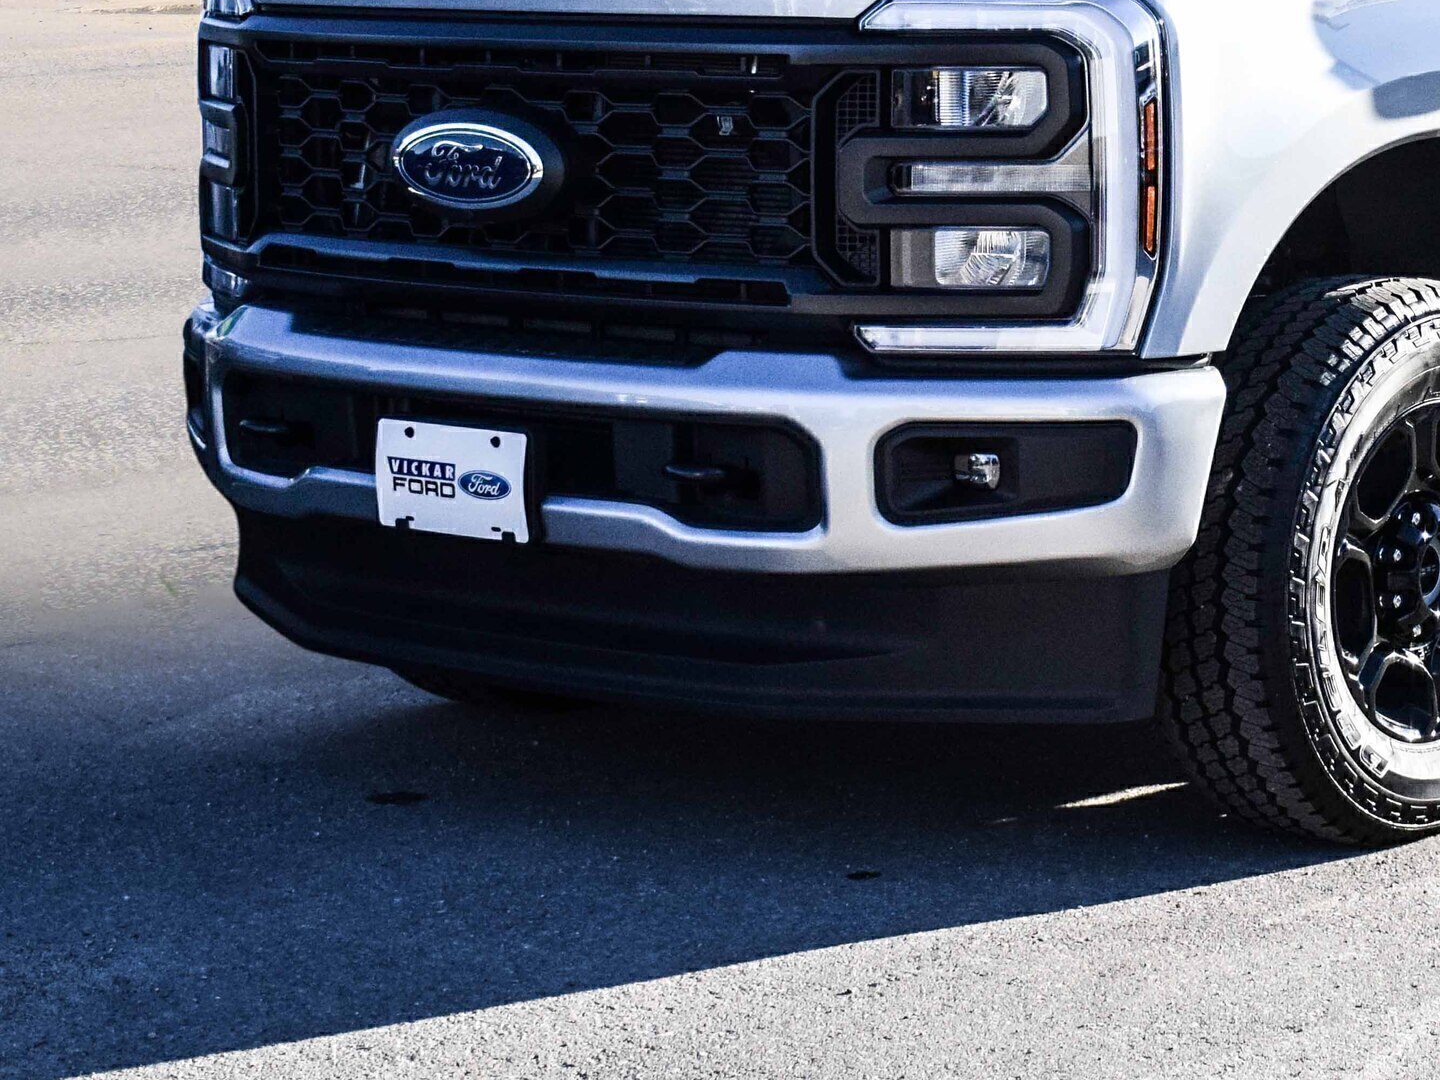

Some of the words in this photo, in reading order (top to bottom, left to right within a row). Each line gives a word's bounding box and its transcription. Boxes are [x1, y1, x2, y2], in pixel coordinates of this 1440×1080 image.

[418, 139, 504, 191] Ford
[391, 458, 456, 480] VICKAR
[393, 476, 456, 499] FORD
[467, 472, 502, 497] Ford
